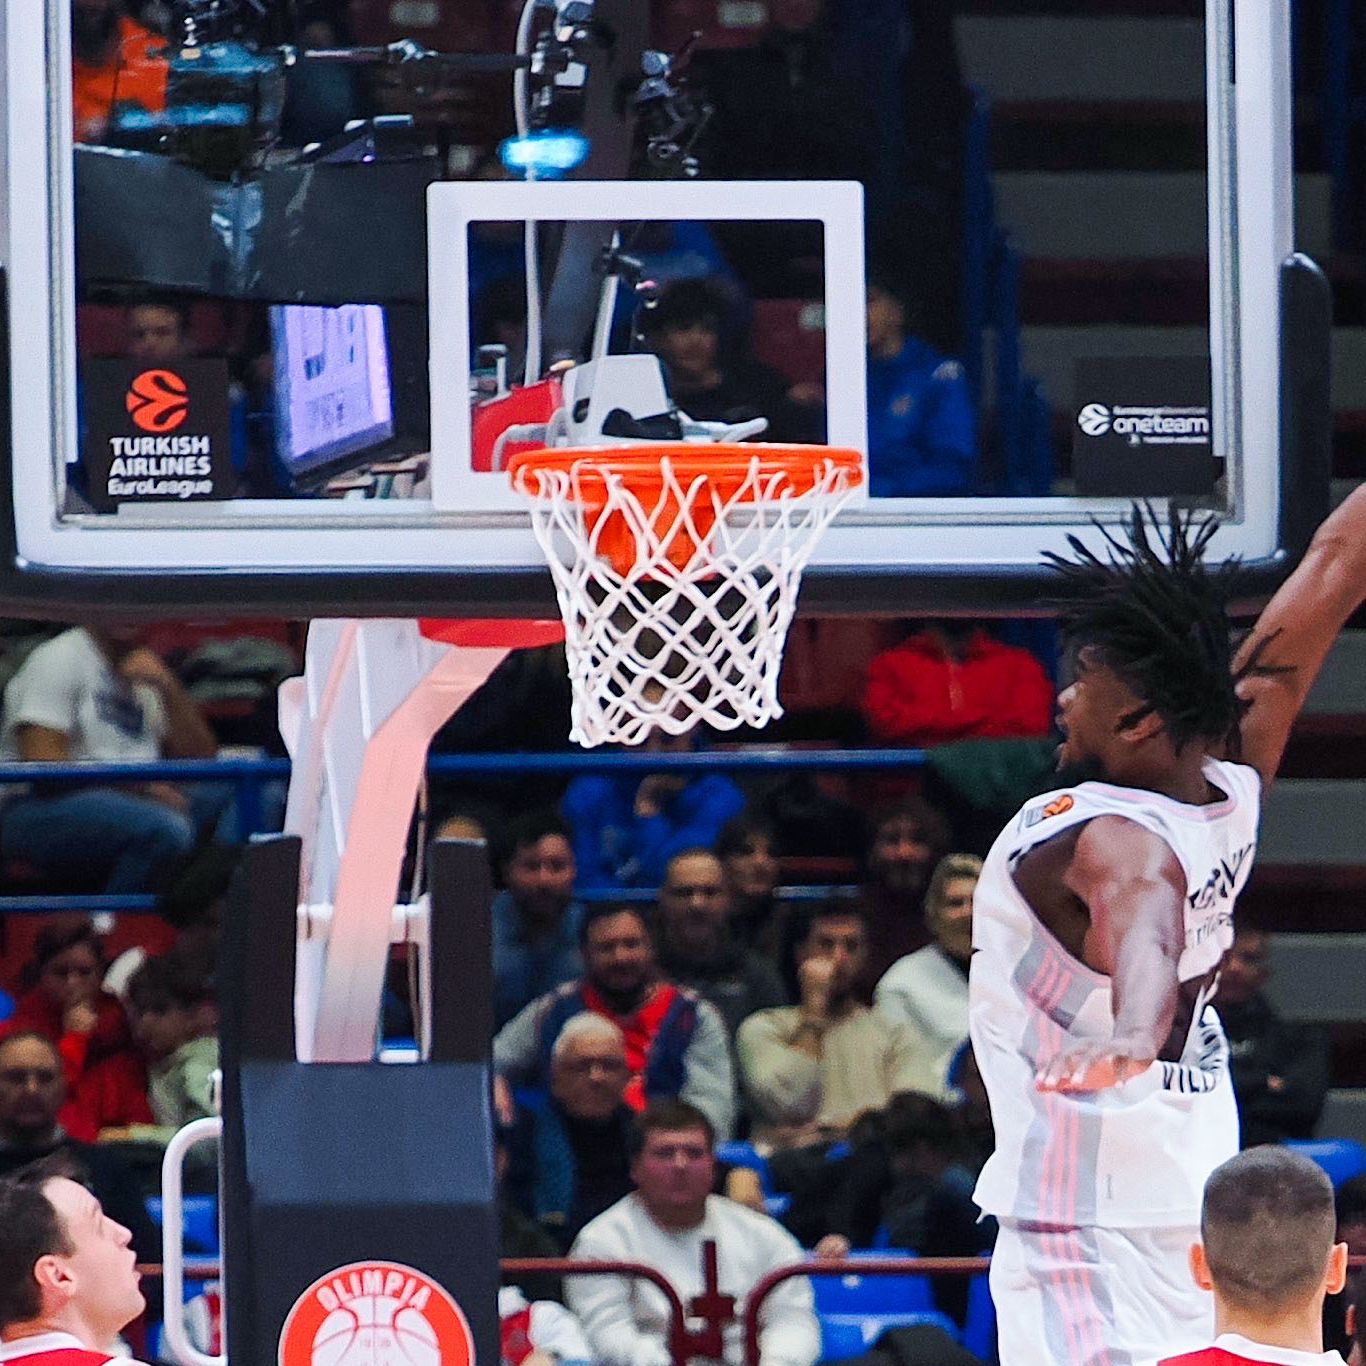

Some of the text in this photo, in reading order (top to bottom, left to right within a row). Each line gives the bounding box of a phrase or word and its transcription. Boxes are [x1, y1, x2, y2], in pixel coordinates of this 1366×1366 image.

[1113, 415, 1209, 434] oneteam
[109, 435, 211, 456] TURKISH
[109, 455, 212, 477] AIRLINES
[107, 477, 213, 498] EuroLeague
[316, 1269, 432, 1313] OLIMPIA
